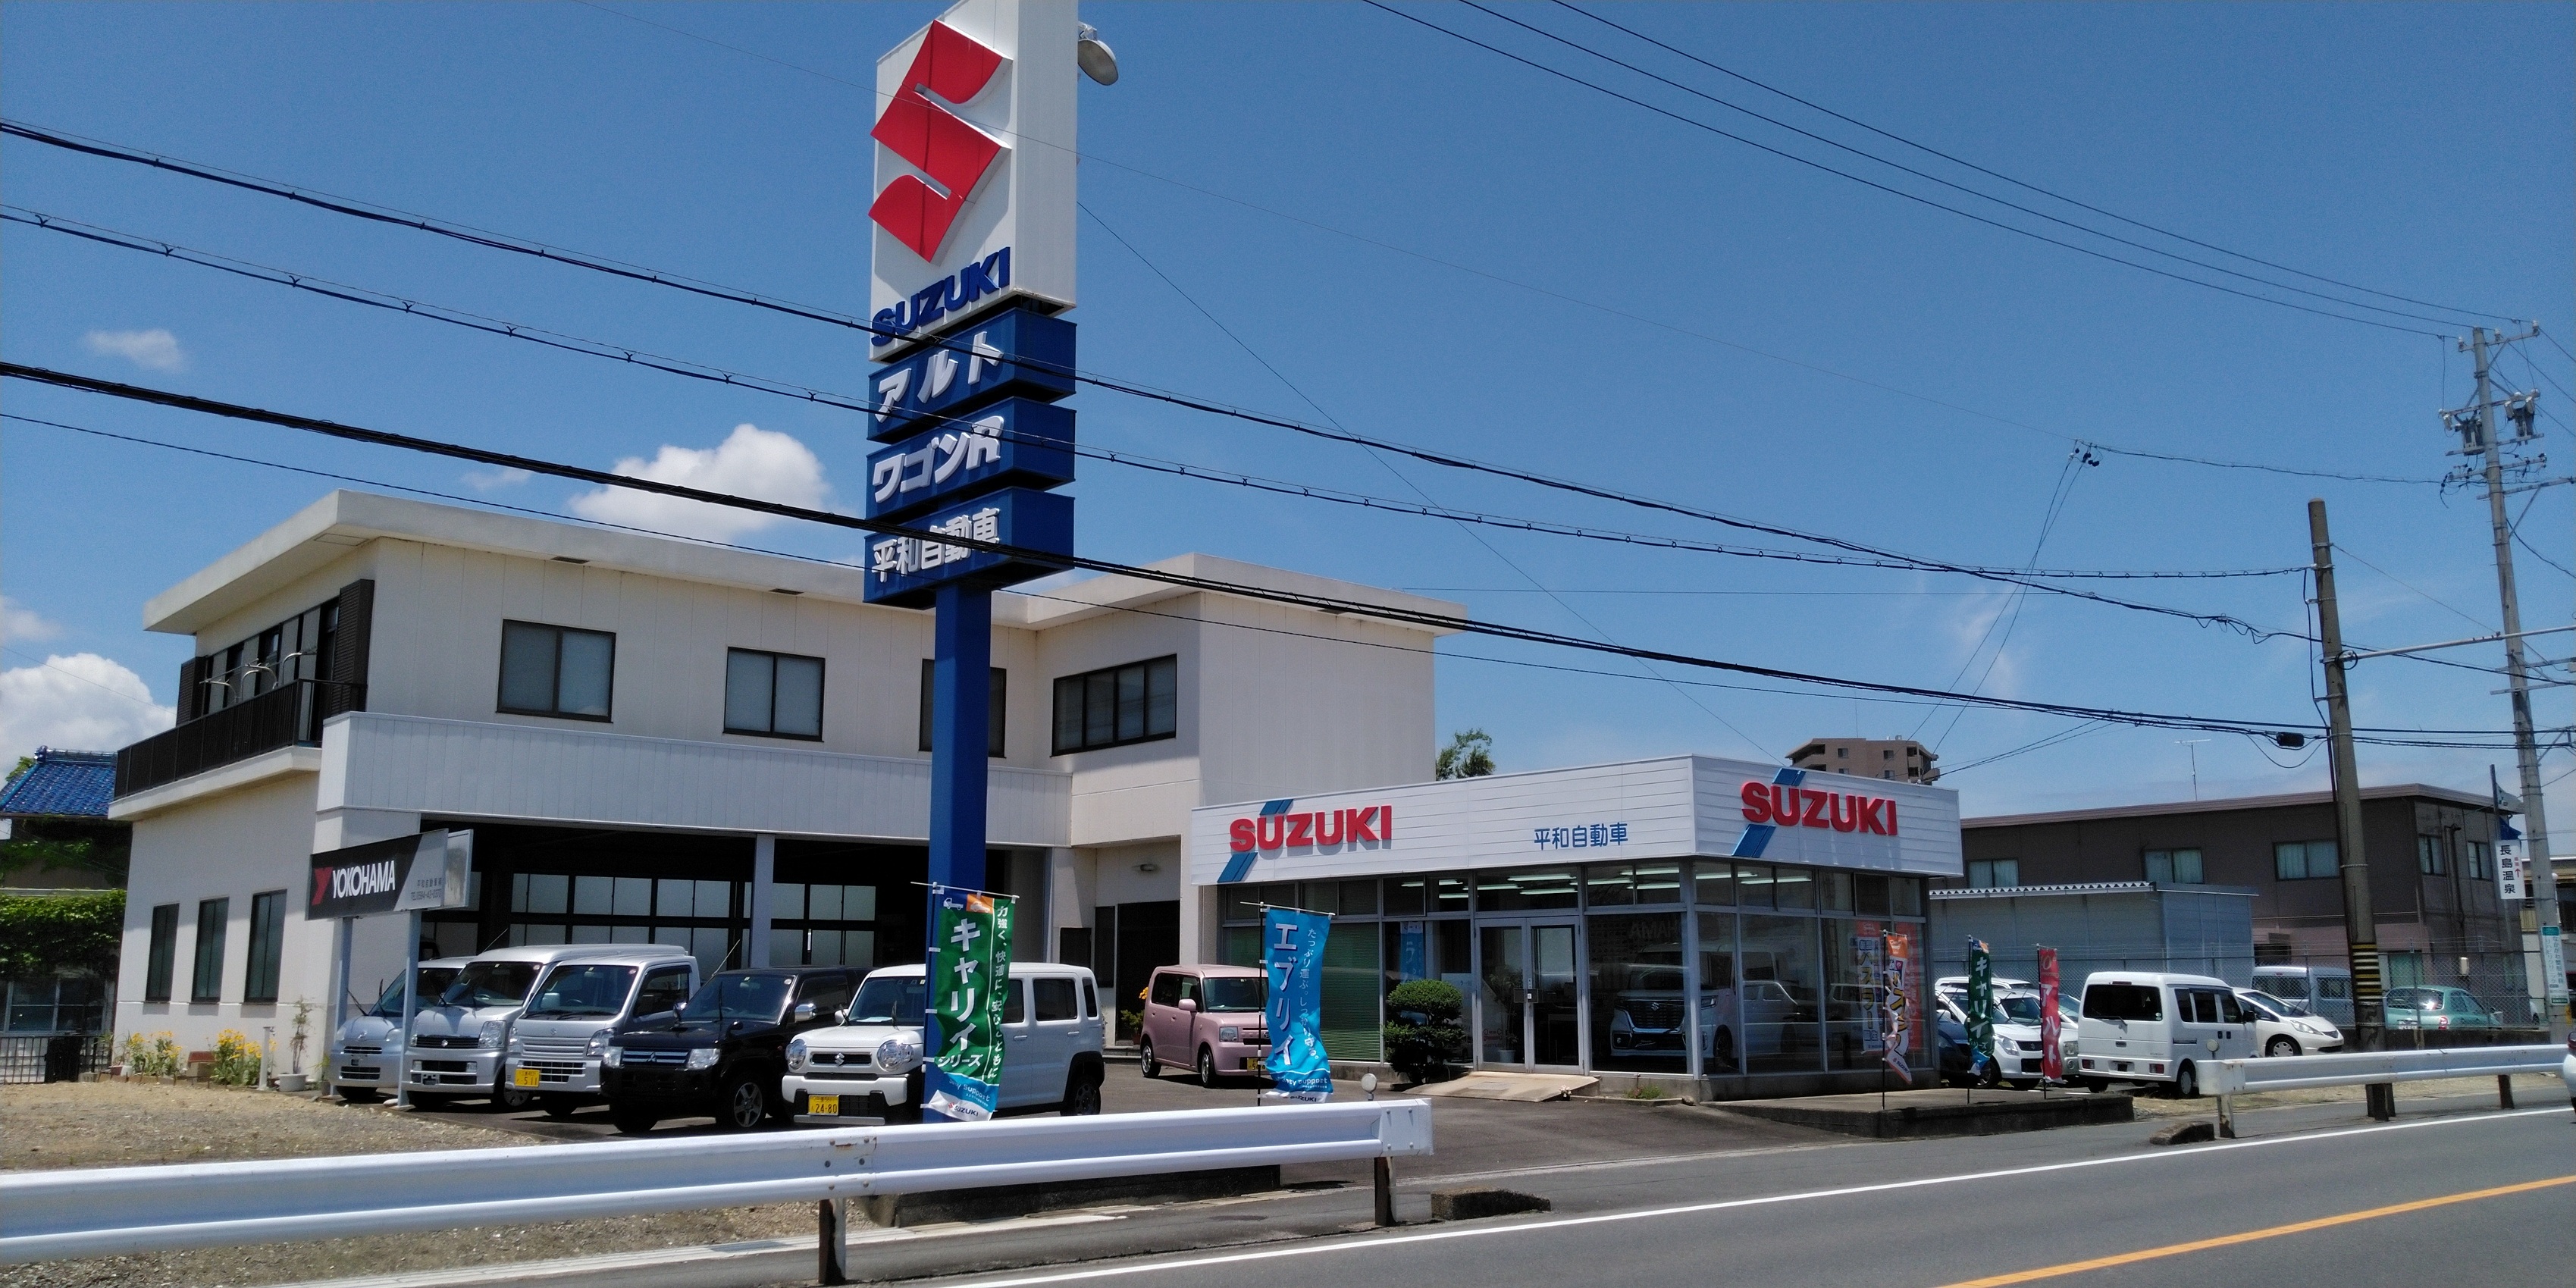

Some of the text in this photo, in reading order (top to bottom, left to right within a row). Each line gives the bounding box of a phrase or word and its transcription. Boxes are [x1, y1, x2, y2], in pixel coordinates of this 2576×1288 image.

[871, 246, 1010, 346] SUZUKI
[875, 331, 1004, 423] アルト
[873, 416, 1004, 503] ワゴンR
[872, 508, 1000, 582] 平和自動車
[1229, 805, 1392, 852] SUZUKI
[1534, 822, 1628, 850] 平和自動車
[1741, 782, 1898, 836] SUZUKI
[333, 860, 395, 898] YOKOHAMA
[2500, 845, 2515, 894] 長島温泉
[951, 918, 980, 1051] キャリイ
[1274, 923, 1298, 1065] エブリイ
[1970, 957, 1989, 1039] キャリイ
[937, 1054, 983, 1067] シリーズ
[815, 1104, 837, 1113] 24-80
[954, 1105, 979, 1117] SUZUKI
